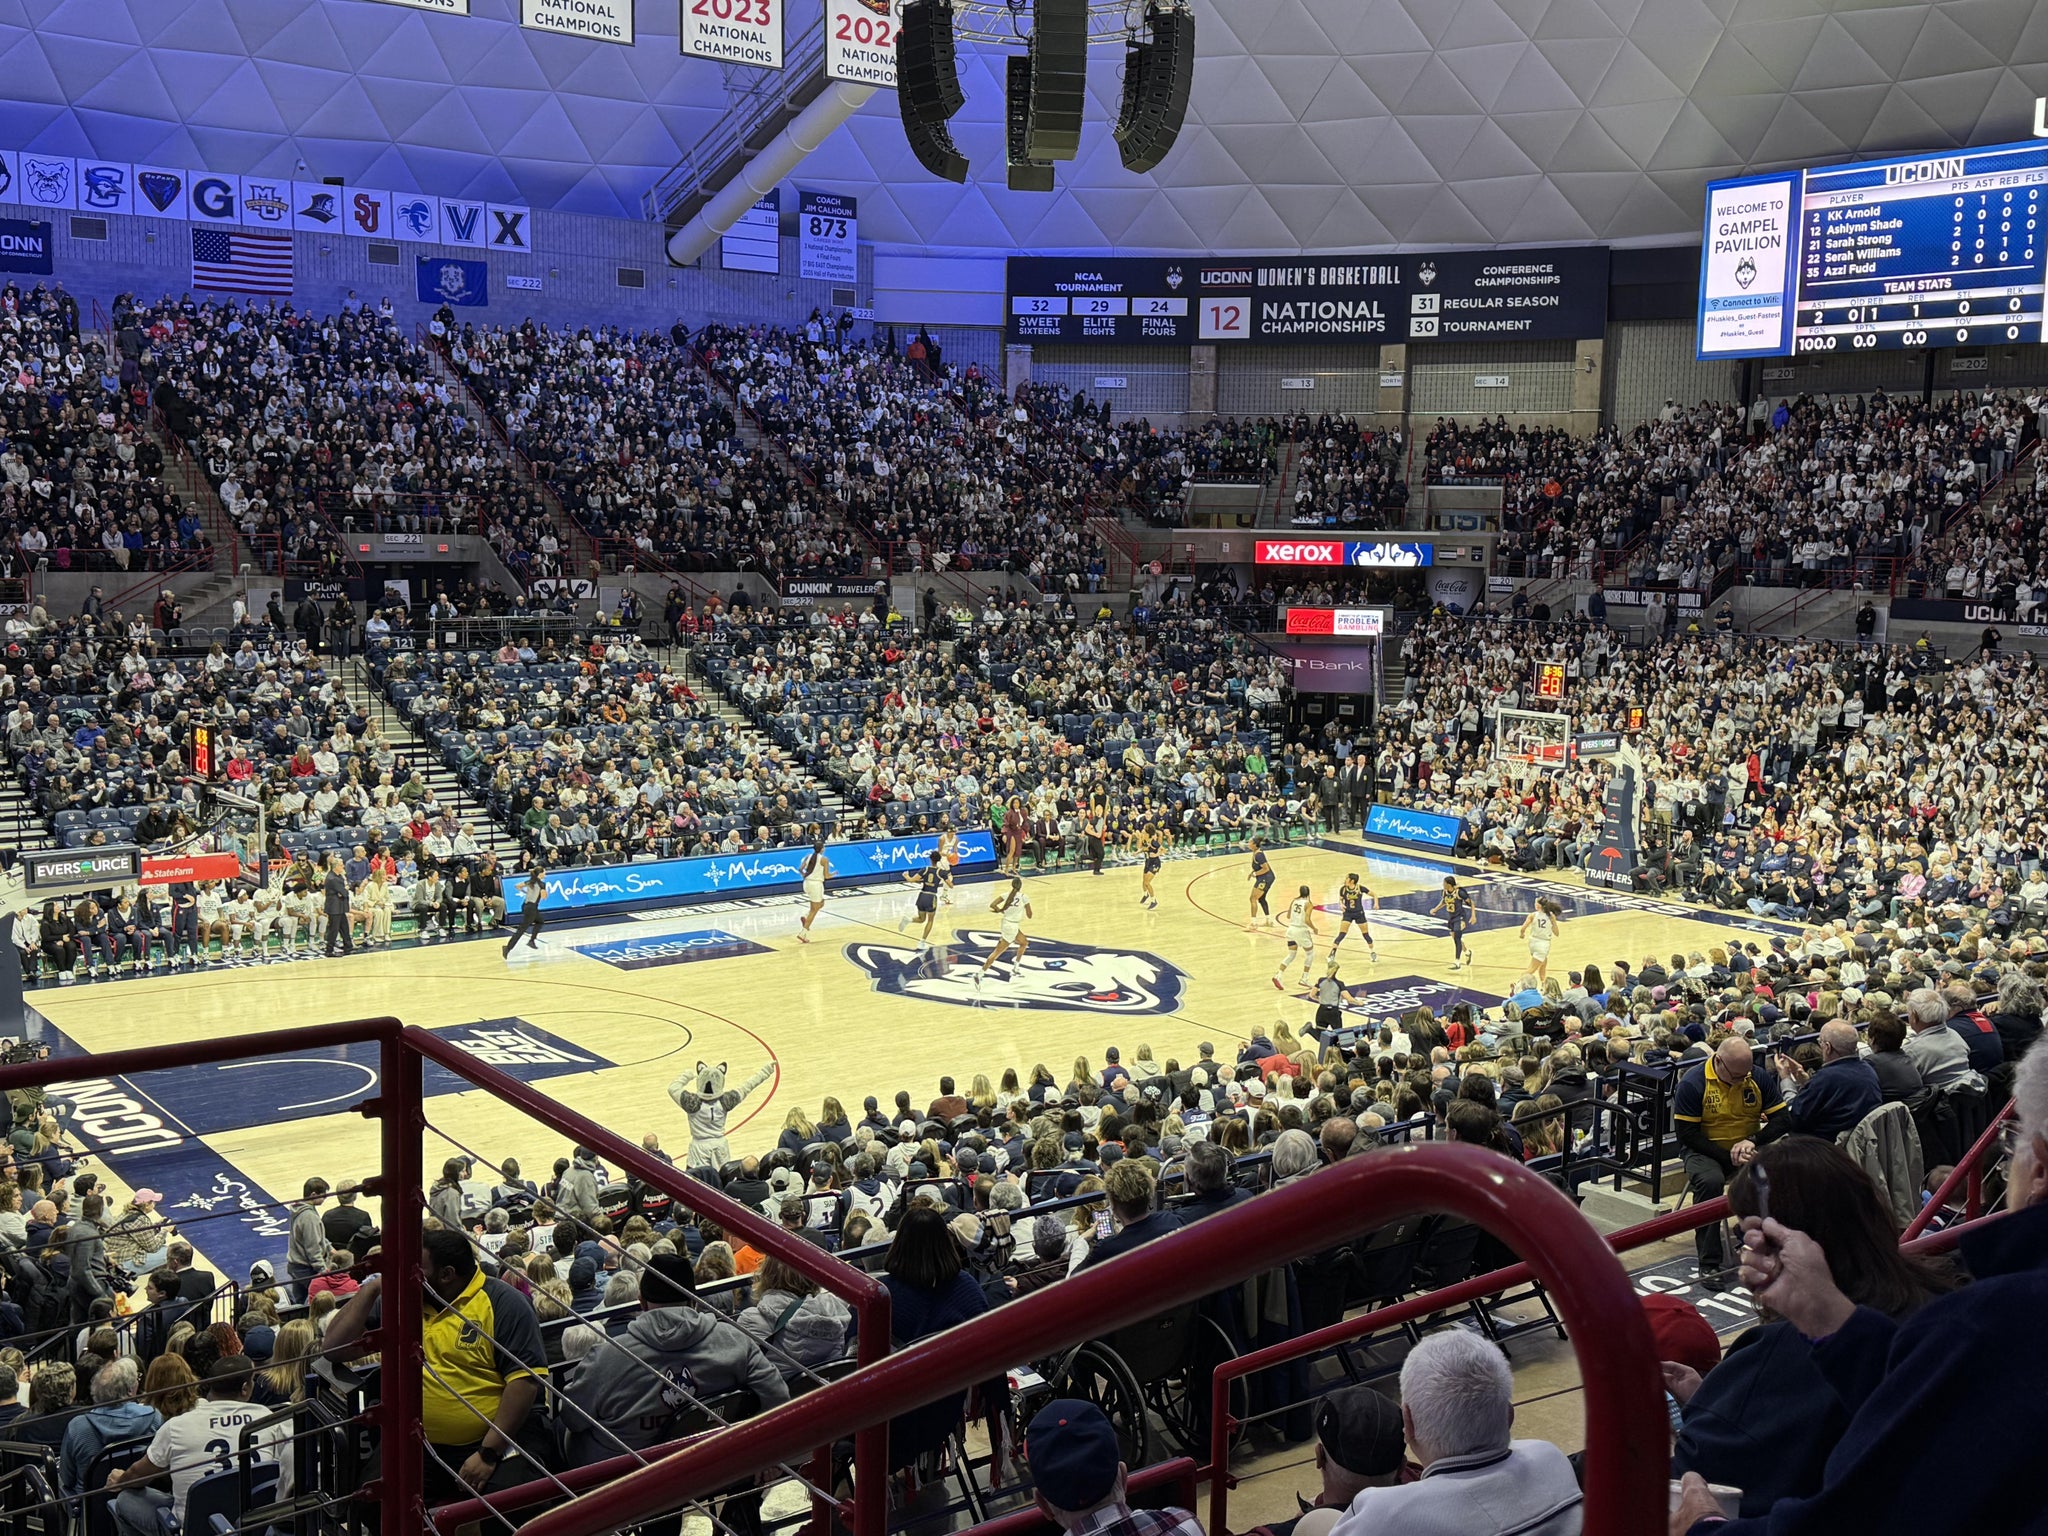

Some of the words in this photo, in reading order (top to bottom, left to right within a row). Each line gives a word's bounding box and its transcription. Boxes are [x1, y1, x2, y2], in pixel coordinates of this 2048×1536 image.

[692, 0, 771, 26] 2023
[535, 13, 621, 37] CHAMPIONS
[699, 23, 767, 44] NATIONAL
[694, 40, 772, 62] CHAMPIONS
[1885, 158, 1965, 185] UCONN
[1829, 193, 1864, 205] PLAYER
[1951, 181, 1969, 191] PTS
[1974, 178, 1994, 190] AST
[1999, 176, 2020, 187] REB
[2025, 173, 2044, 184] FLS
[193, 178, 236, 218] G
[816, 196, 841, 205] COACH
[354, 193, 380, 233] SJ
[804, 204, 817, 213] JIM
[817, 205, 853, 217] CALHOUN
[1716, 202, 1767, 217] WELCOME
[1769, 200, 1784, 211] TO
[1813, 213, 1820, 223] 2
[1827, 210, 1843, 221] KK
[1845, 206, 1881, 219] Arnold
[1955, 197, 1964, 208] 0
[2004, 192, 2013, 203] 0
[2029, 189, 2038, 200] 0
[442, 203, 482, 243] V
[809, 216, 847, 239] 873
[1719, 217, 1779, 237] GAMPEL
[1810, 227, 1821, 237] 12
[1826, 223, 1868, 236] Ashlynn
[1870, 218, 1903, 231] Shade
[1954, 211, 1963, 223] 0
[1977, 209, 1987, 220] 0
[2002, 206, 2012, 218] 0
[2027, 204, 2037, 215] 0
[489, 210, 528, 249] X
[1809, 240, 1820, 250] 21
[1825, 236, 1857, 249] Sarah
[1859, 233, 1892, 248] Strong
[1953, 226, 1961, 237] 2
[2001, 221, 2011, 232] 0
[2026, 218, 2036, 230] 0
[1714, 234, 1781, 254] PAVILION
[1807, 253, 1820, 264] 22
[1825, 250, 1854, 263] Serah
[1856, 246, 1902, 260] Williams
[1952, 240, 1961, 252] 0
[1975, 238, 1985, 250] 0
[1483, 264, 1553, 275] CONFERENCE
[1806, 267, 1820, 278] 35
[1824, 265, 1847, 277] Azzi
[1849, 262, 1876, 275] Fudd
[1951, 254, 1960, 266] 2
[1974, 253, 1984, 264] 0
[1999, 250, 2009, 262] 0
[2024, 248, 2034, 260] 0
[1074, 273, 1103, 281] NCAA
[1200, 271, 1252, 285] UCONN
[1257, 267, 1315, 287] WOMEN'S
[1320, 266, 1400, 286] BASKETBALL
[1474, 276, 1561, 287] CHAMPIONSHIPS
[522, 279, 542, 290] 222
[1054, 283, 1123, 292] TOURNAMENT
[1884, 280, 1916, 293] TEAM
[1917, 278, 1952, 290] STATS
[1031, 300, 1049, 312] 32
[1418, 297, 1433, 310] 31
[1443, 298, 1503, 309] REGULAR
[1506, 296, 1559, 308] SEASON
[1722, 298, 1753, 308] Connect
[1811, 300, 1827, 310] AST
[1866, 296, 1884, 306] REB
[1908, 294, 1925, 303] REB
[1957, 290, 1972, 299] STL
[2007, 287, 2024, 296] BLK
[1090, 300, 1109, 313] 29
[1150, 301, 1169, 313] 24
[1262, 301, 1385, 320] NATIONAL
[1814, 311, 1824, 324] 2
[1958, 301, 1970, 314] 0
[2009, 297, 2021, 311] 0
[858, 310, 874, 319] 223
[1019, 317, 1061, 327] SWEET
[1083, 317, 1115, 327] ELITE
[1210, 305, 1240, 331] 12
[1142, 318, 1176, 328] FINAL
[1261, 320, 1386, 333] CHAMPIONSHIPS
[1414, 320, 1435, 333] 30
[1443, 320, 1532, 332] TOURNAMENT
[1809, 325, 1826, 335] FG%
[1855, 323, 1877, 332] 3PT%
[1906, 320, 1924, 329] FT%
[2005, 314, 2024, 322] PTO
[1019, 327, 1061, 335] SIXTEENS
[1083, 327, 1115, 336] EIGHTS
[1142, 328, 1176, 336] FOURS
[1799, 336, 1837, 351] 100.0
[1853, 333, 1877, 348] 0.0
[1902, 330, 1927, 346] 0.0
[1956, 328, 1968, 342] 0
[2007, 325, 2019, 340] 0
[1966, 360, 1987, 369] 202
[1495, 377, 1505, 386] 14
[1777, 369, 1795, 379] 201
[1113, 379, 1124, 387] 12
[1300, 379, 1311, 388] 13
[403, 533, 423, 543] 221
[1265, 544, 1333, 562] xerox
[789, 583, 833, 594] DUNKIN'
[837, 585, 878, 594] TRAVELERS
[796, 597, 814, 606] 222
[1678, 593, 1701, 608] WORLD
[1337, 617, 1379, 625] PROBLEM
[1685, 610, 1704, 618] 202
[1337, 624, 1379, 632] GAMBLING
[395, 637, 416, 649] 121
[709, 632, 727, 643] 122
[1309, 660, 1364, 671] Bank
[1543, 666, 1563, 677] 8:36
[1539, 676, 1560, 696] 28
[1581, 738, 1616, 751] EVERSOURCE
[195, 745, 208, 773] 28
[1388, 818, 1429, 839] Mohegan
[1432, 826, 1452, 840] Sun
[957, 841, 987, 858] Sun
[37, 857, 129, 878] EVERSOURCE
[728, 857, 800, 881] Mohegan
[1585, 867, 1633, 885] TRAVELERS
[545, 877, 625, 900] Mohegan
[626, 873, 664, 893] Sun
[1472, 872, 1699, 915] HUSKIES
[627, 901, 759, 921] BASKETBALL
[1293, 903, 1302, 915] 35
[1537, 918, 1547, 929] 12
[589, 935, 738, 958] MADISON
[602, 948, 682, 964] REED
[1348, 998, 1421, 1016] REED
[212, 1172, 246, 1203] Sun
[869, 1197, 884, 1218] 2
[209, 1414, 253, 1429] FUDD
